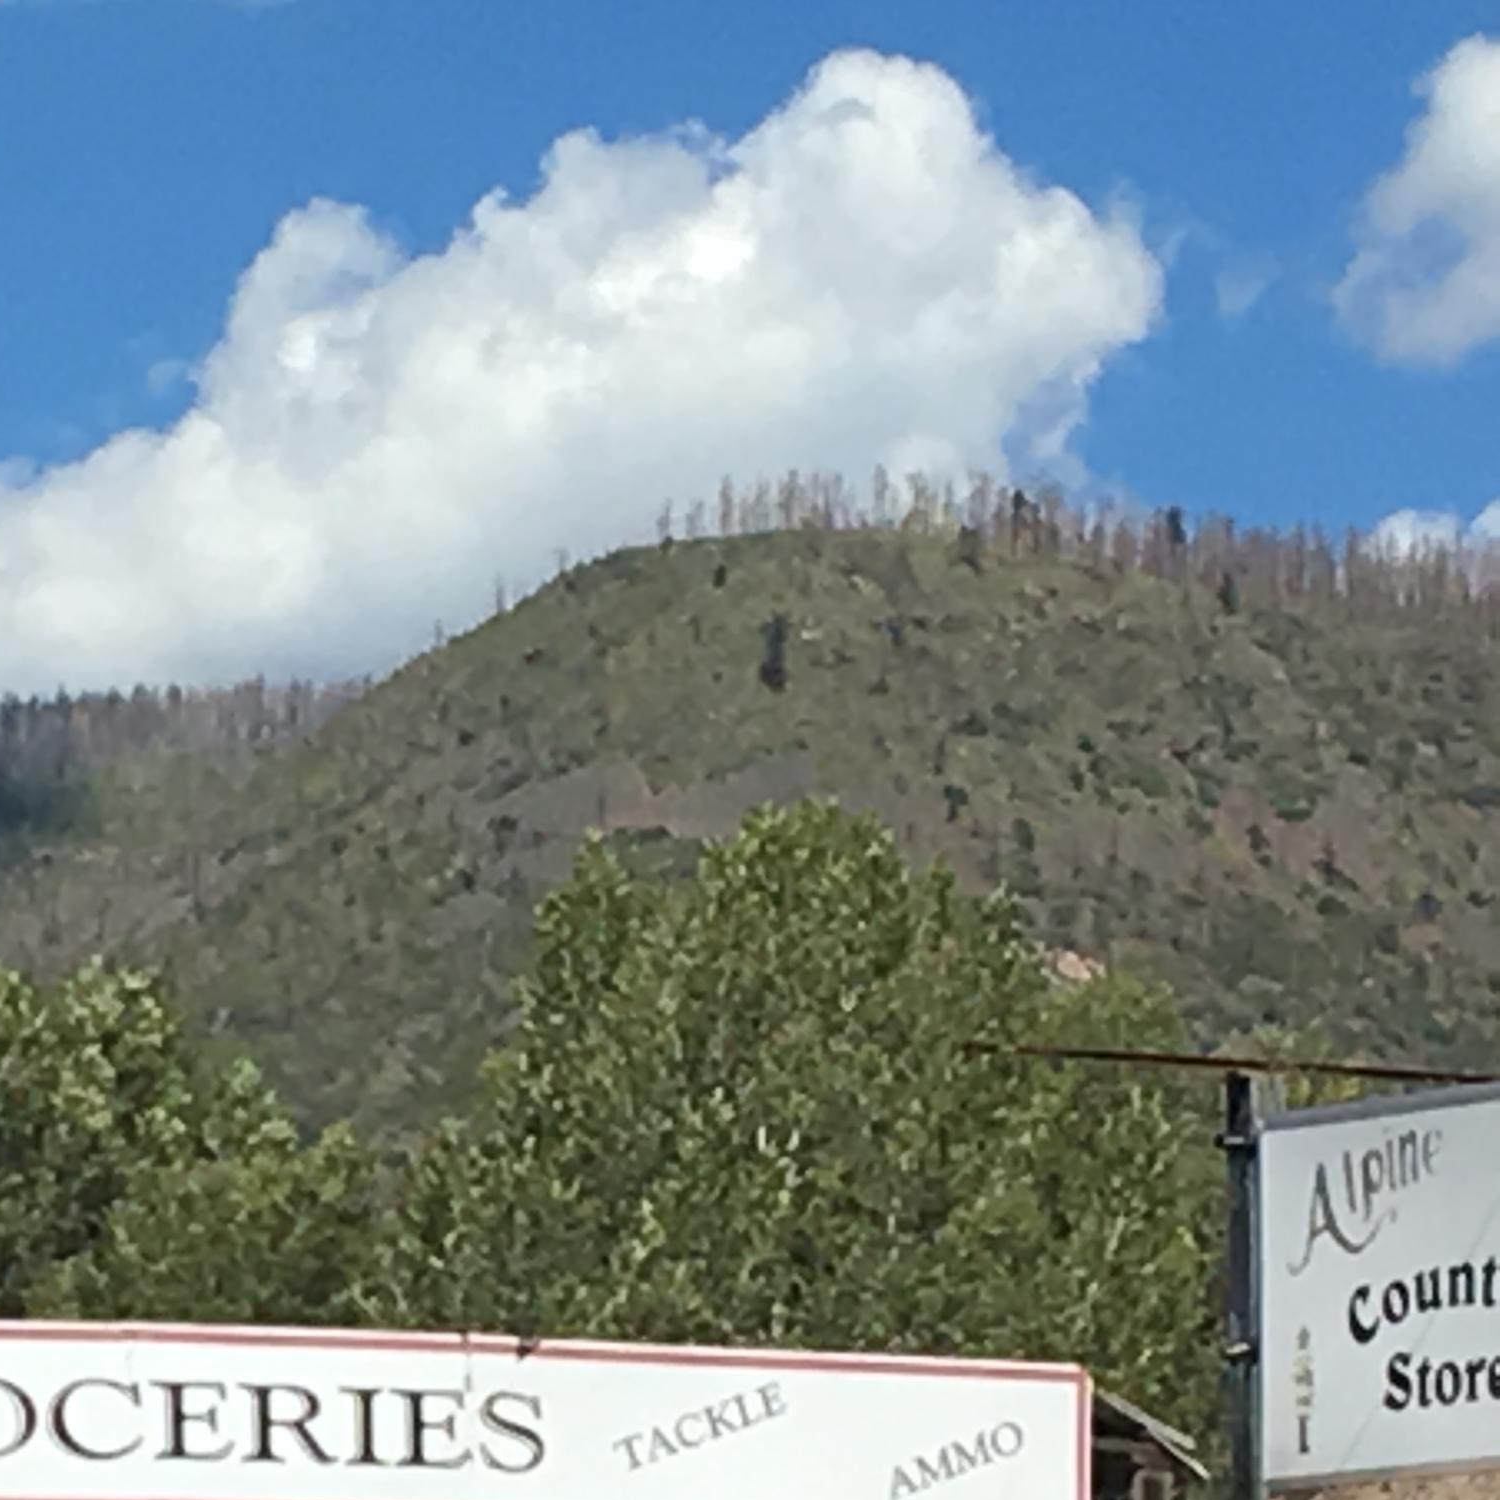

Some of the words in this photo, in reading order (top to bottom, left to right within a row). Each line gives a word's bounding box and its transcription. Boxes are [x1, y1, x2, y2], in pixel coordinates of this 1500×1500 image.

[1286, 1126, 1443, 1277] Alpine
[1347, 1255, 1500, 1344] Count
[613, 1381, 788, 1471] TACKLE
